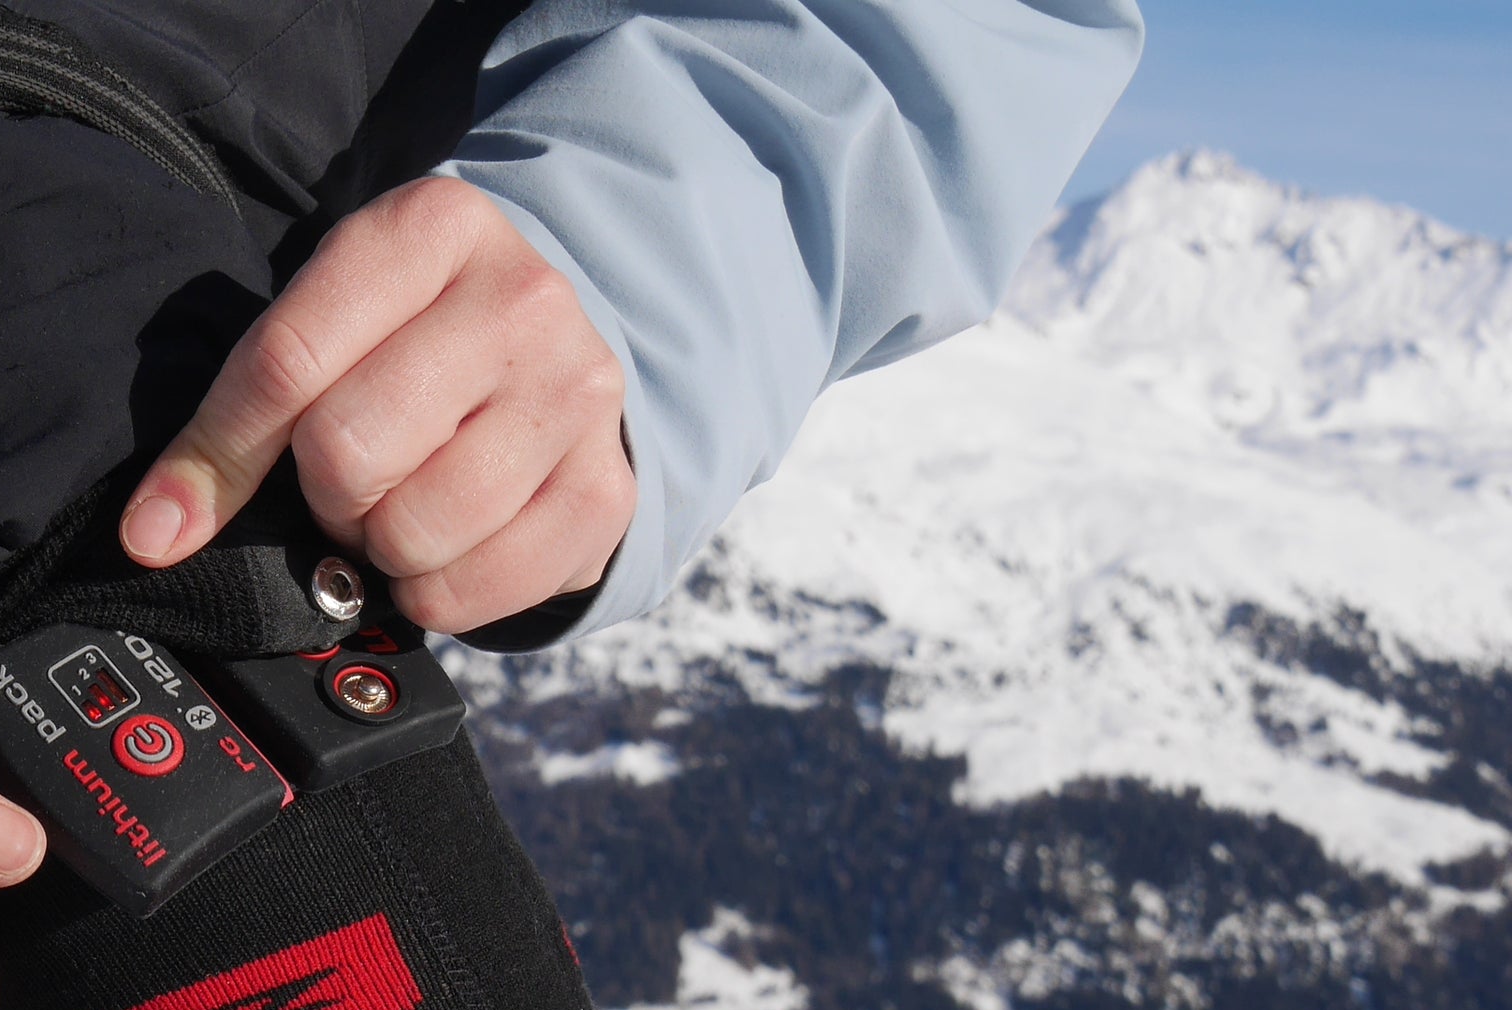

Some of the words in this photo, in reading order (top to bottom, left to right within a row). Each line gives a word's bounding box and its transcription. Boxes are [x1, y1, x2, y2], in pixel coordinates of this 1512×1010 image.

[71, 685, 82, 696] 1
[78, 667, 90, 680] 2
[85, 652, 97, 664] 3
[116, 630, 182, 698] 120
[63, 749, 167, 867] lithium
